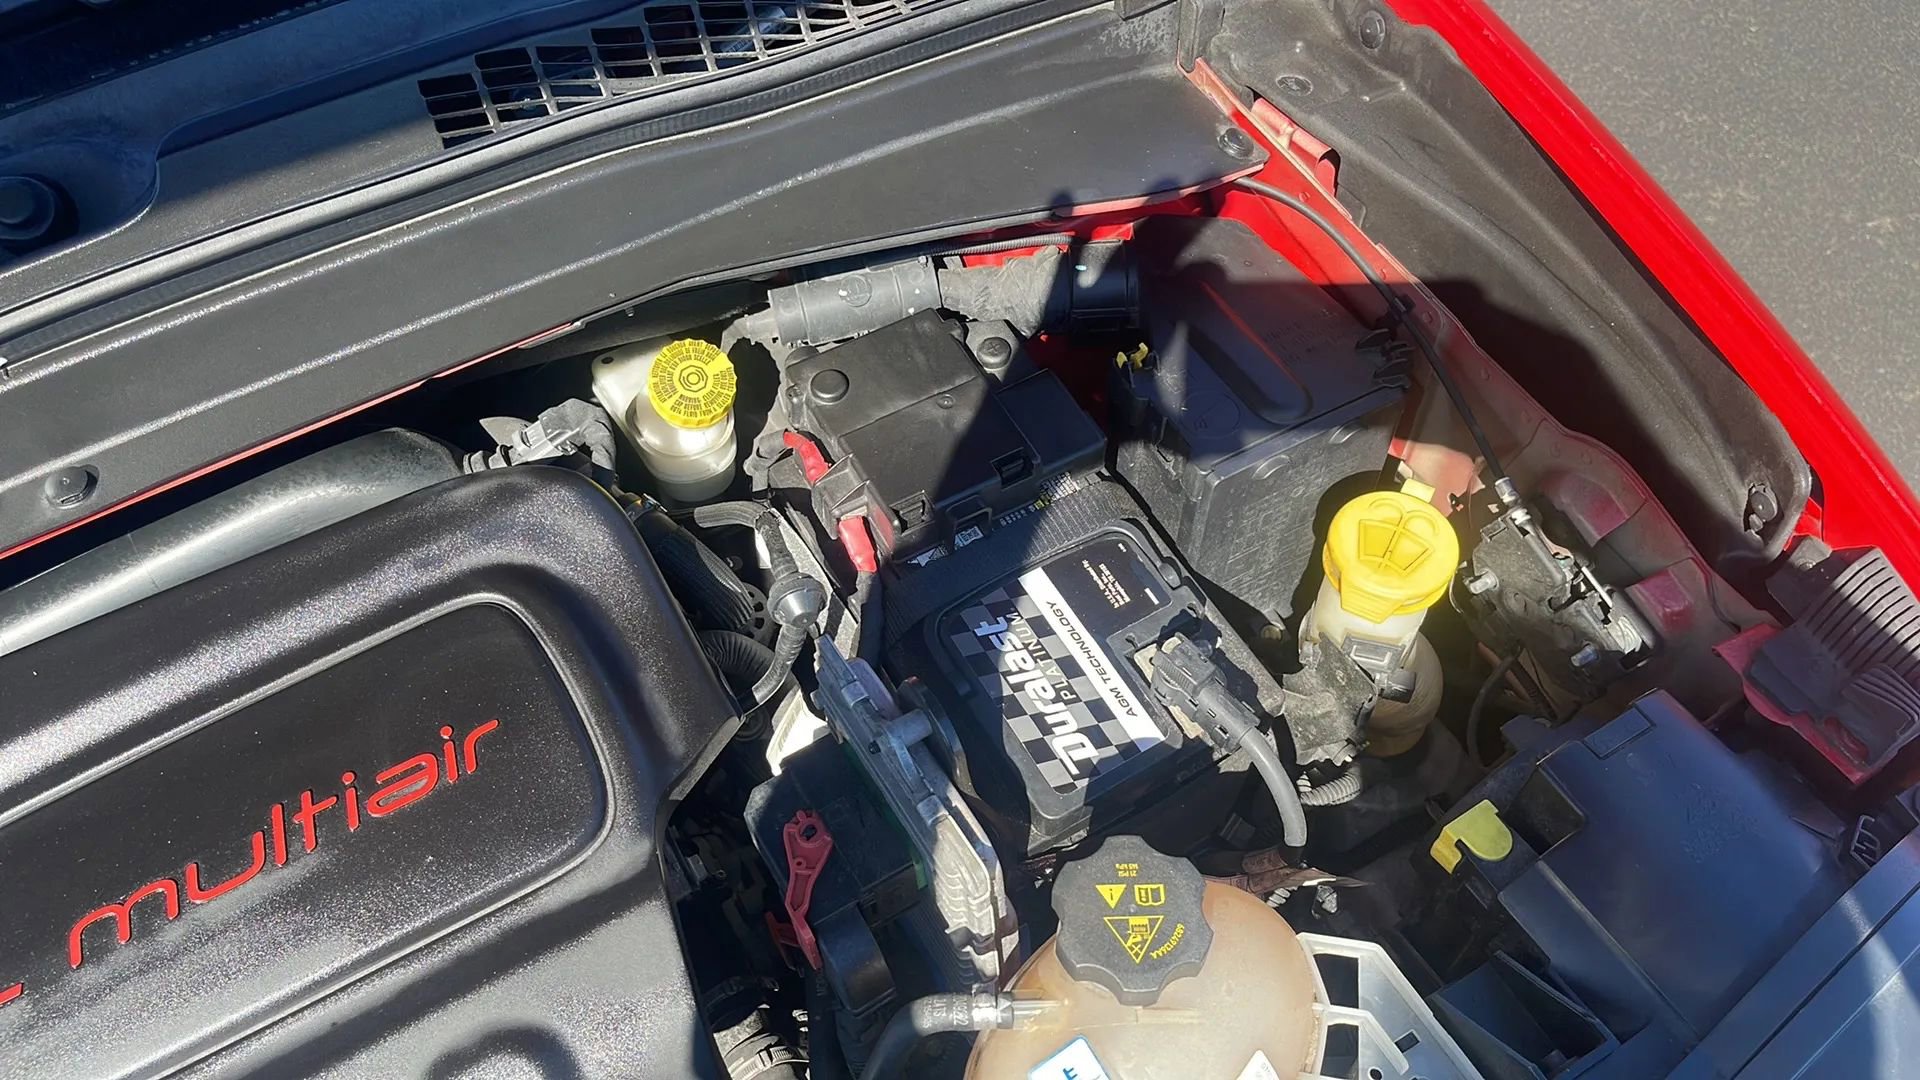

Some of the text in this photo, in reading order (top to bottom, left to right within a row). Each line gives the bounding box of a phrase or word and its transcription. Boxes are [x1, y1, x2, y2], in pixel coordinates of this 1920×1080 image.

[973, 616, 1100, 776] Duralast
[1046, 600, 1139, 718] AGM TECHNOLOGY
[67, 718, 499, 970] multiair
